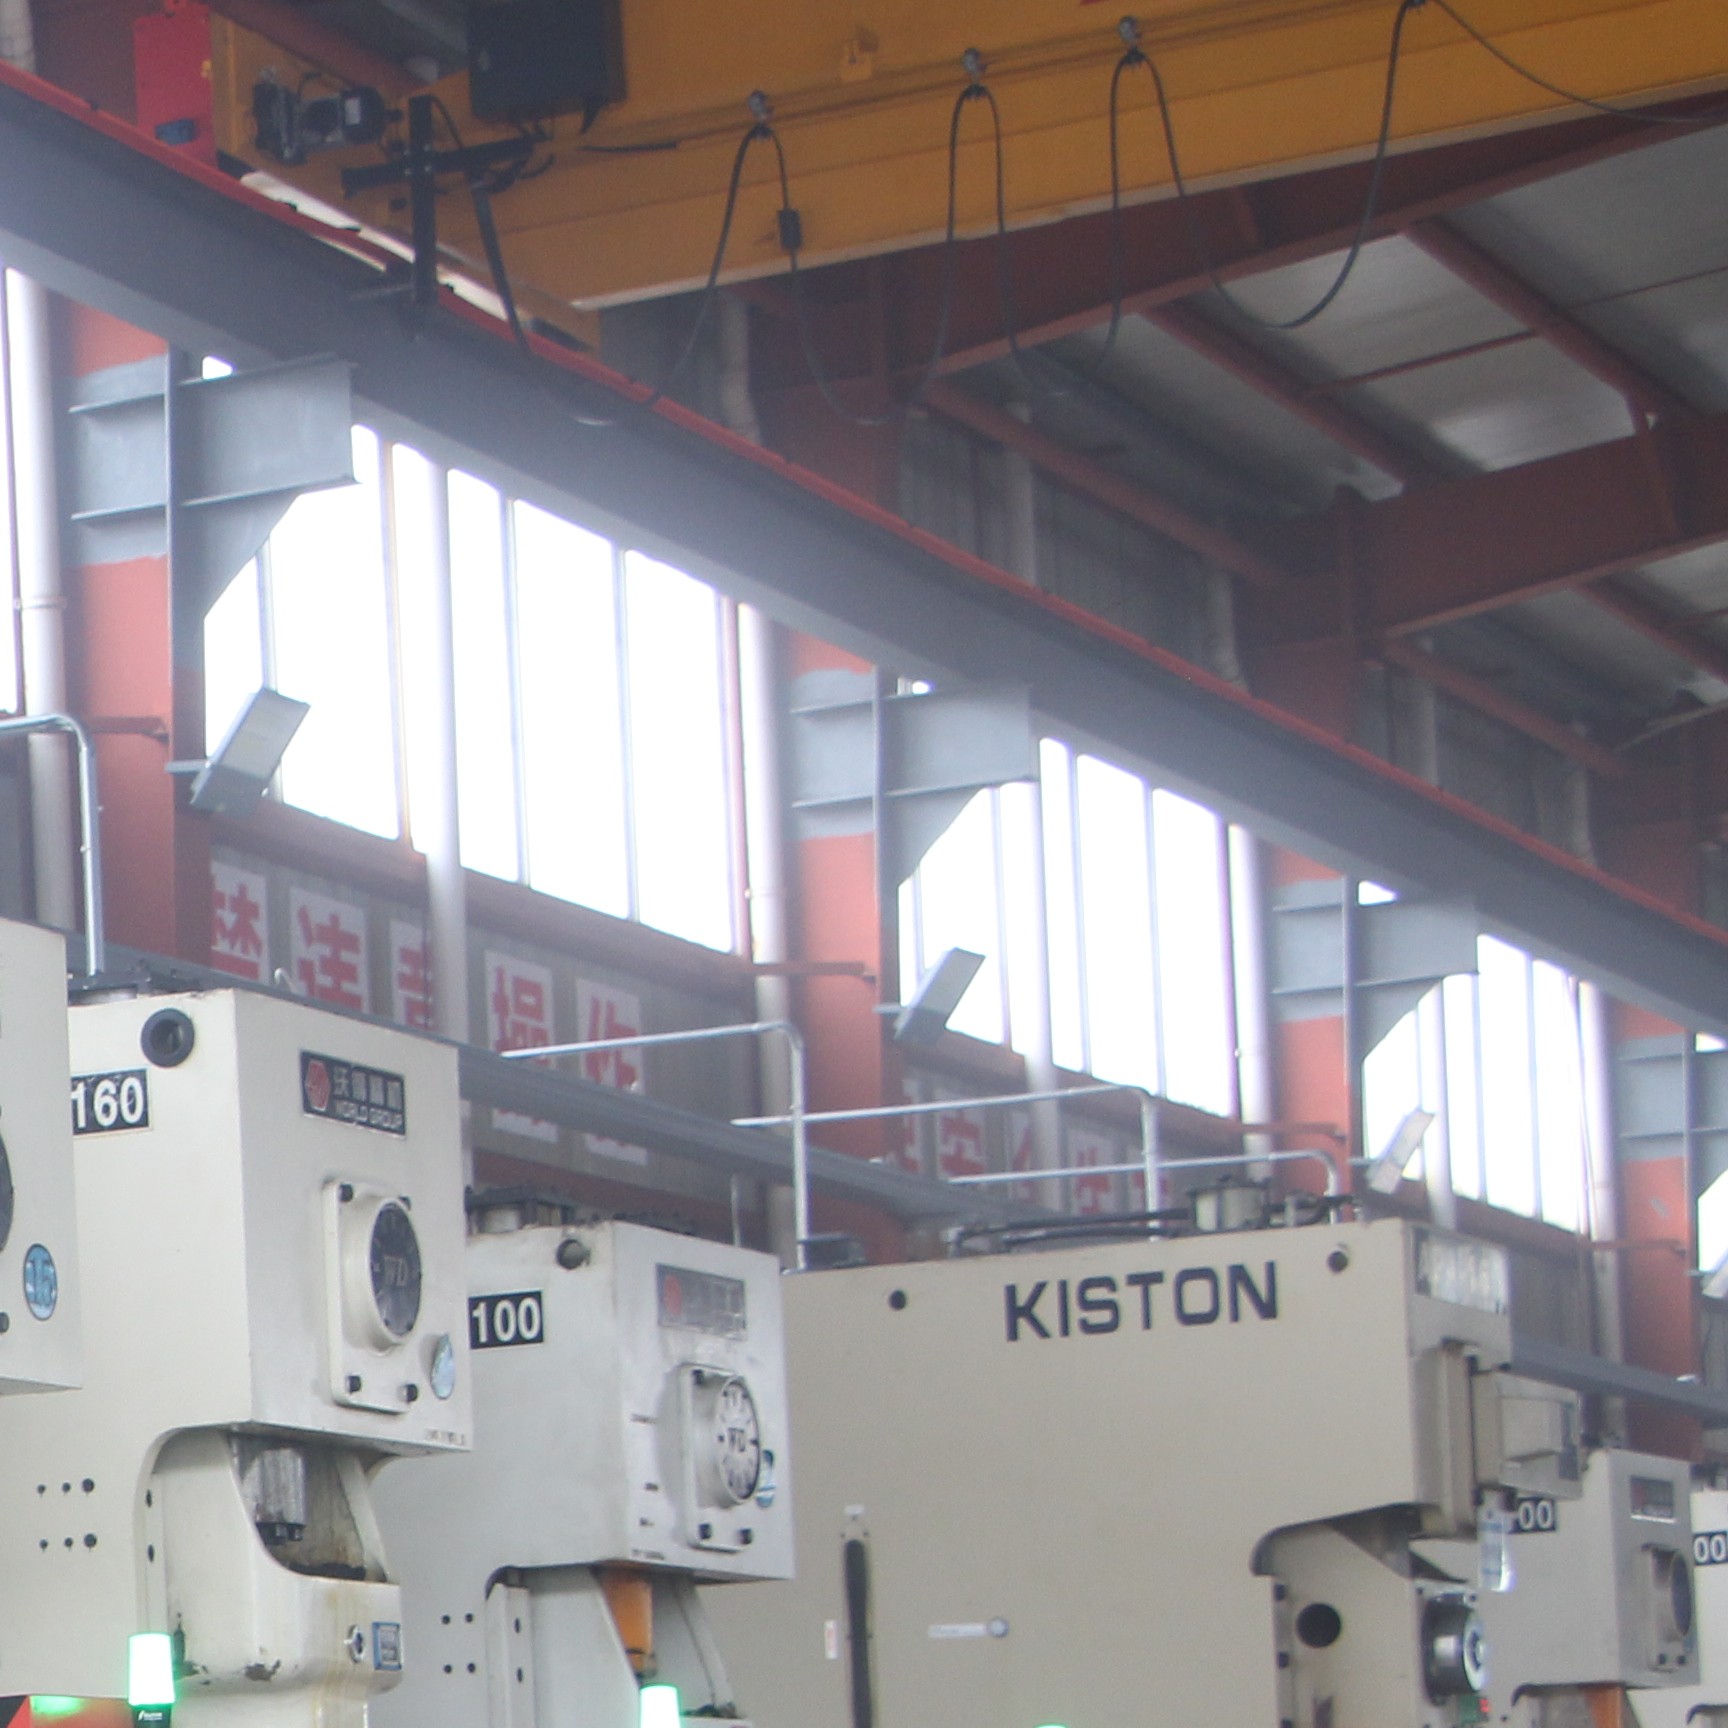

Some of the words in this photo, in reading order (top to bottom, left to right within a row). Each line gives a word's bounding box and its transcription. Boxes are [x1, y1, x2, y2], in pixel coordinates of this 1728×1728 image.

[71, 1075, 144, 1129] 160
[472, 1297, 541, 1344] 100
[1004, 1259, 1279, 1343] KISTON
